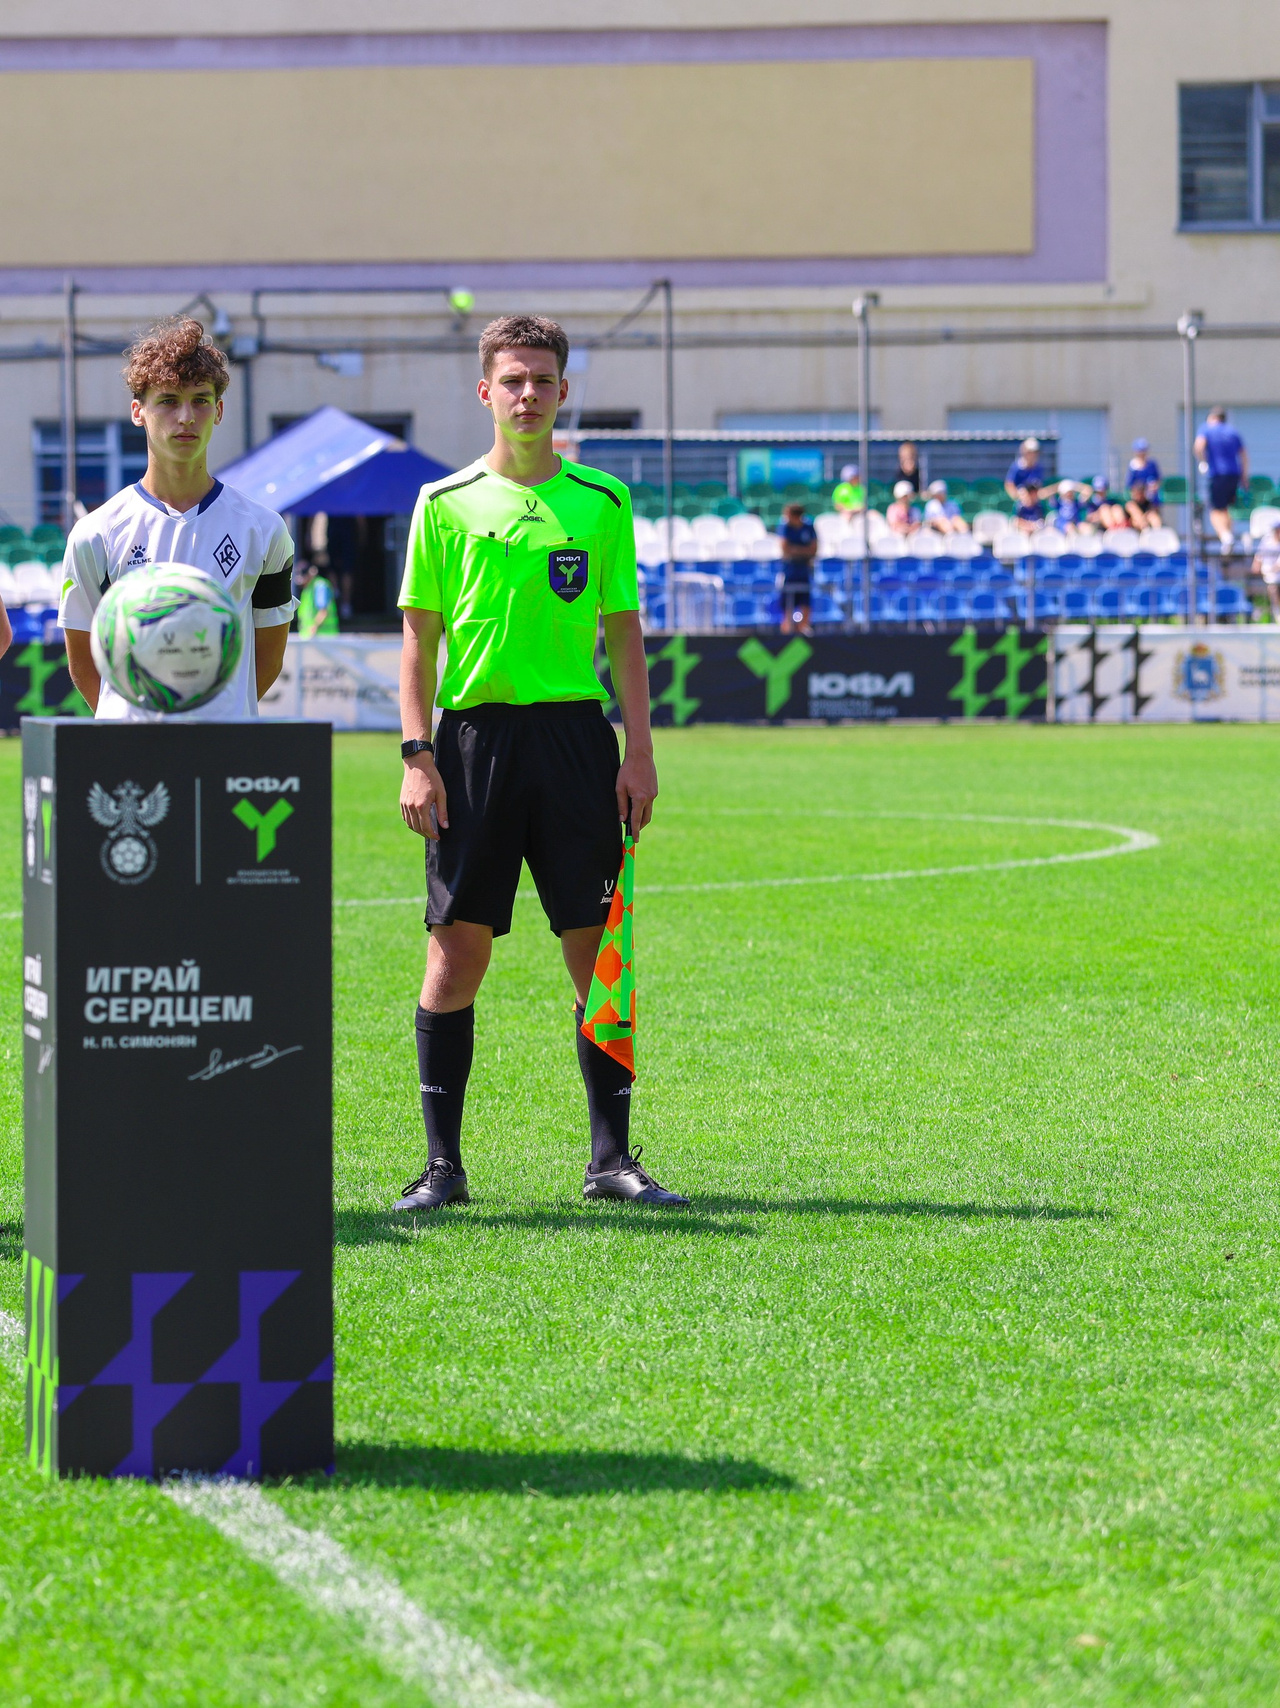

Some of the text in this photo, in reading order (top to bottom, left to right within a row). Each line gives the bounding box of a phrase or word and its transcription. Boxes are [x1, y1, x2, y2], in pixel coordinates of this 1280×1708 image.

[517, 515, 546, 523] JÖGEL
[127, 558, 152, 566] KELME
[226, 776, 300, 793] ЮФЛ
[86, 959, 200, 993] ИГРАЙ
[84, 996, 253, 1028] СЕРДЦЕМ
[83, 1035, 99, 1049] Н.
[101, 1035, 118, 1049] П.
